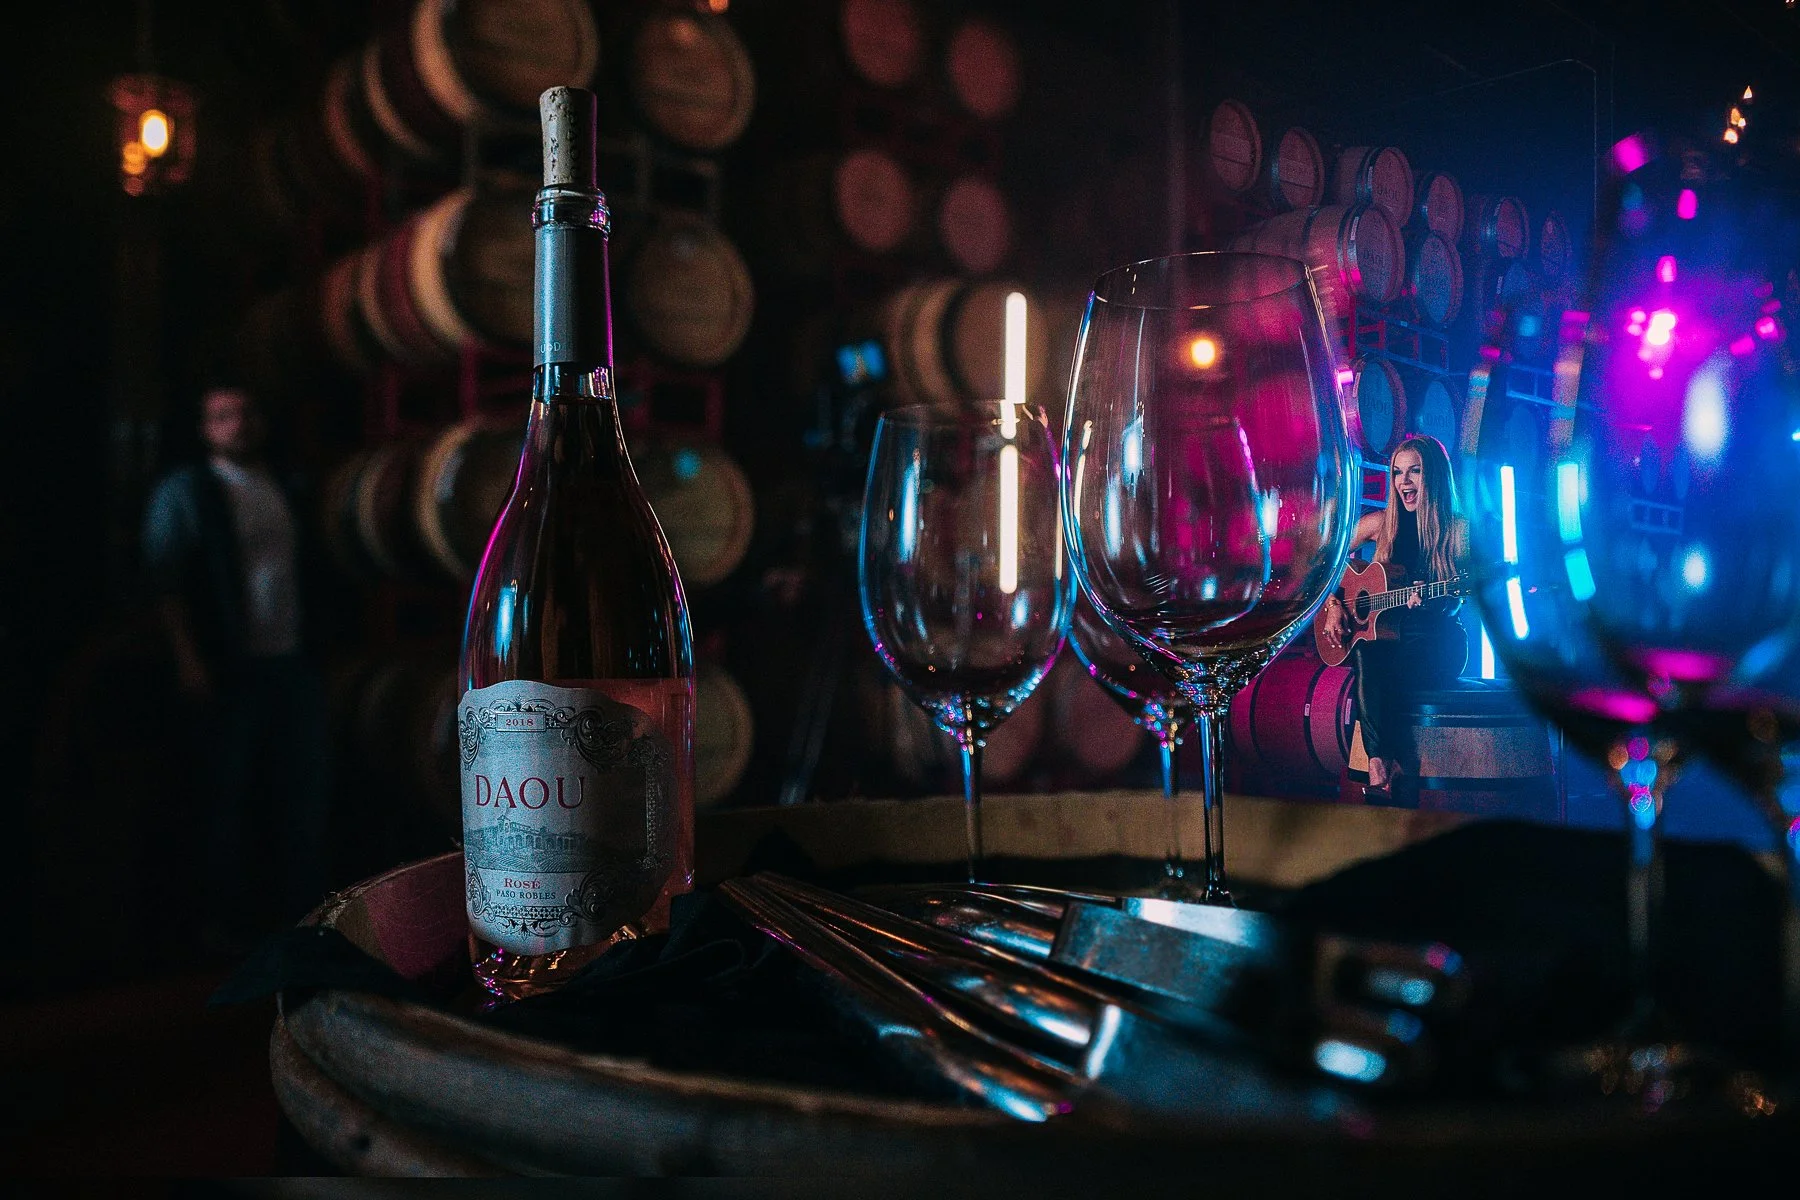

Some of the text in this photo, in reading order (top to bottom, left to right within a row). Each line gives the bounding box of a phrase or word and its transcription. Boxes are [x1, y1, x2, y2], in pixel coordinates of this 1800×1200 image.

[505, 718, 535, 727] 2018
[475, 774, 586, 810] DAOU
[496, 889, 557, 900] PASO ROBLES
